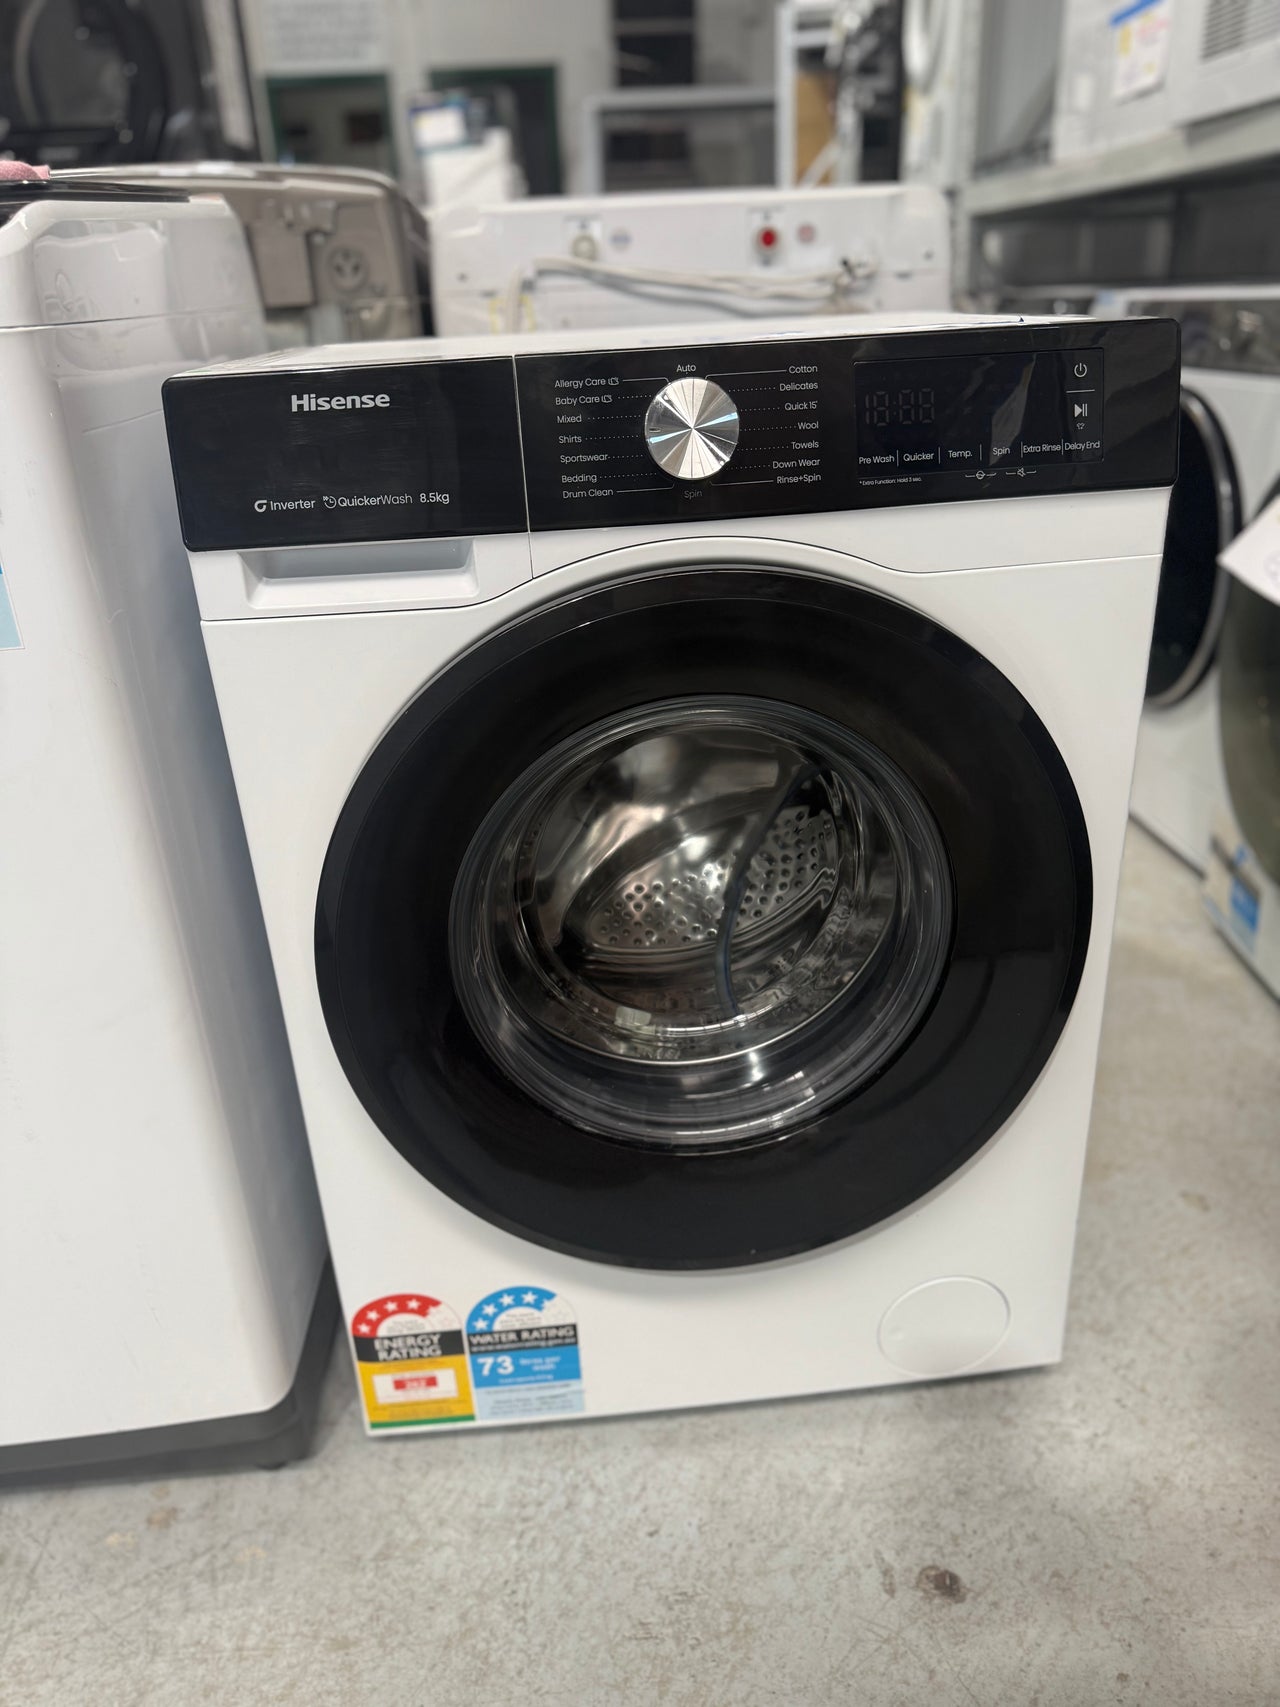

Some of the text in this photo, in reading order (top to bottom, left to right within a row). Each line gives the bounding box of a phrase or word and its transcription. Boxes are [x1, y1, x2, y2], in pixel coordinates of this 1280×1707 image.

[676, 364, 697, 373] Auto
[788, 365, 818, 374] Cotton
[554, 377, 606, 389] Allergy Care
[779, 382, 819, 392] Delicates
[291, 393, 391, 413] Hisense
[555, 395, 600, 407] Baby Care
[784, 401, 808, 411] Quick
[556, 414, 582, 424] Mixed
[797, 421, 819, 430] Wool
[558, 434, 582, 444] Shirts
[791, 440, 819, 450] Towels
[1022, 443, 1062, 454] Extra Rinse
[1064, 440, 1100, 451] Delay End
[903, 452, 935, 462] Quicker
[947, 449, 973, 459] Temp.
[992, 446, 1011, 457] Spin
[559, 453, 609, 464] Sportswear
[772, 458, 820, 469] Down Wear
[858, 454, 895, 465] Pre Wash
[561, 473, 598, 484] Bedding
[776, 473, 822, 484] Rinse+Spin
[562, 488, 614, 499] Drum Clean
[683, 489, 703, 500] Spin
[270, 492, 451, 511] Inverter QuickerWash 8.5kg
[469, 1331, 518, 1345] WATER
[520, 1326, 575, 1341] RATING
[374, 1334, 441, 1351] ENERGY
[377, 1346, 442, 1362] RATING
[477, 1354, 515, 1376] 73
